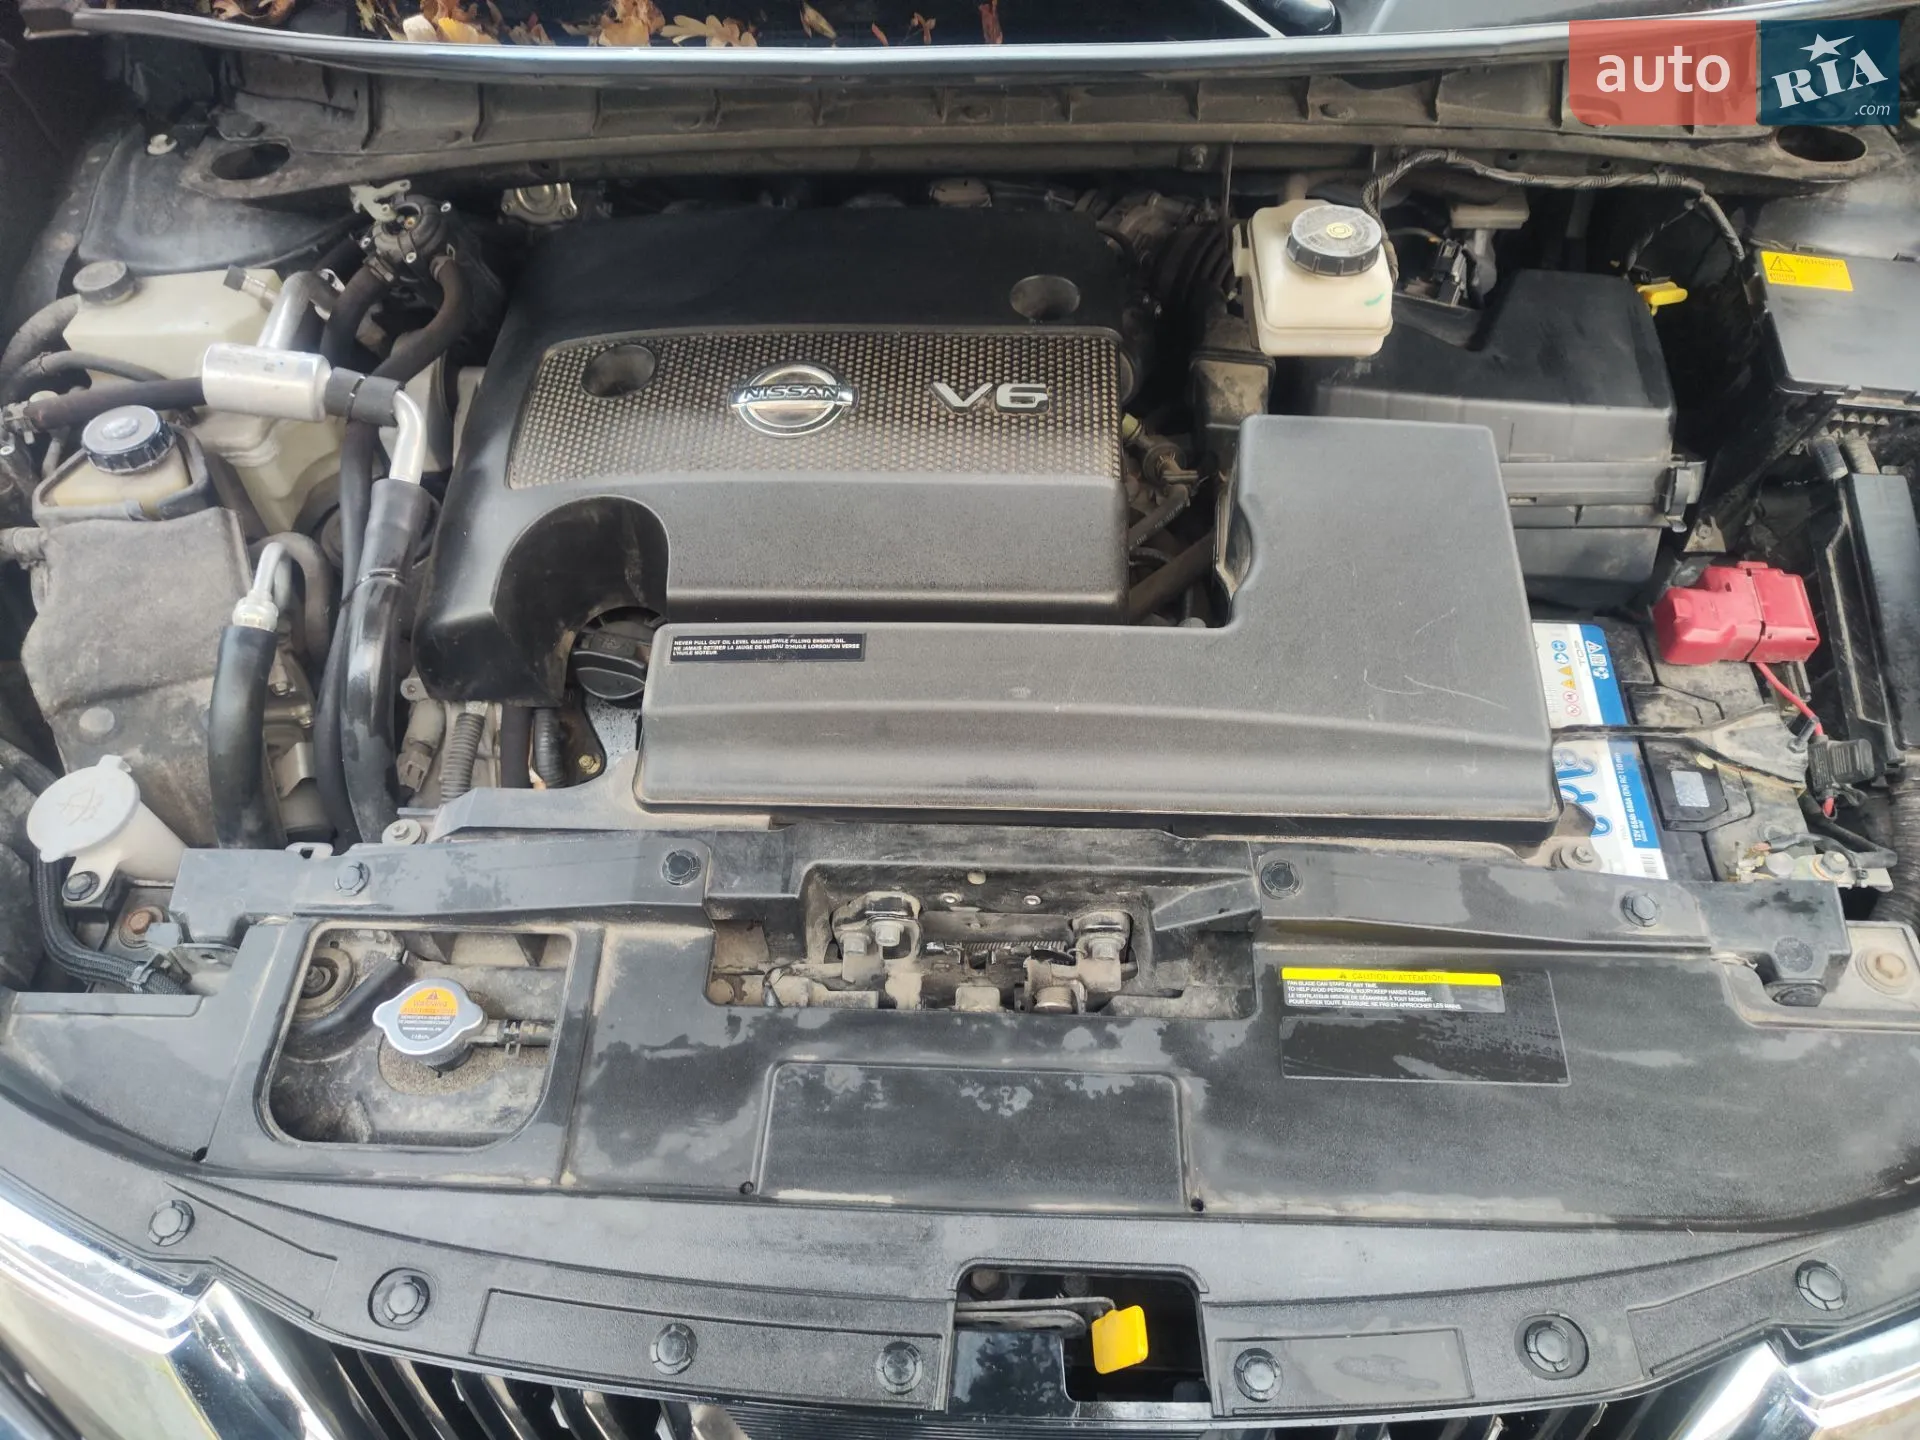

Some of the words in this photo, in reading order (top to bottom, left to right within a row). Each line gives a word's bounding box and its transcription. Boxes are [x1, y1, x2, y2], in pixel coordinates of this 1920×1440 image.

[743, 384, 841, 399] NISSAN
[930, 382, 1051, 415] V6
[1351, 972, 1389, 981] CAUTION
[1398, 974, 1444, 982] ATTENTION
